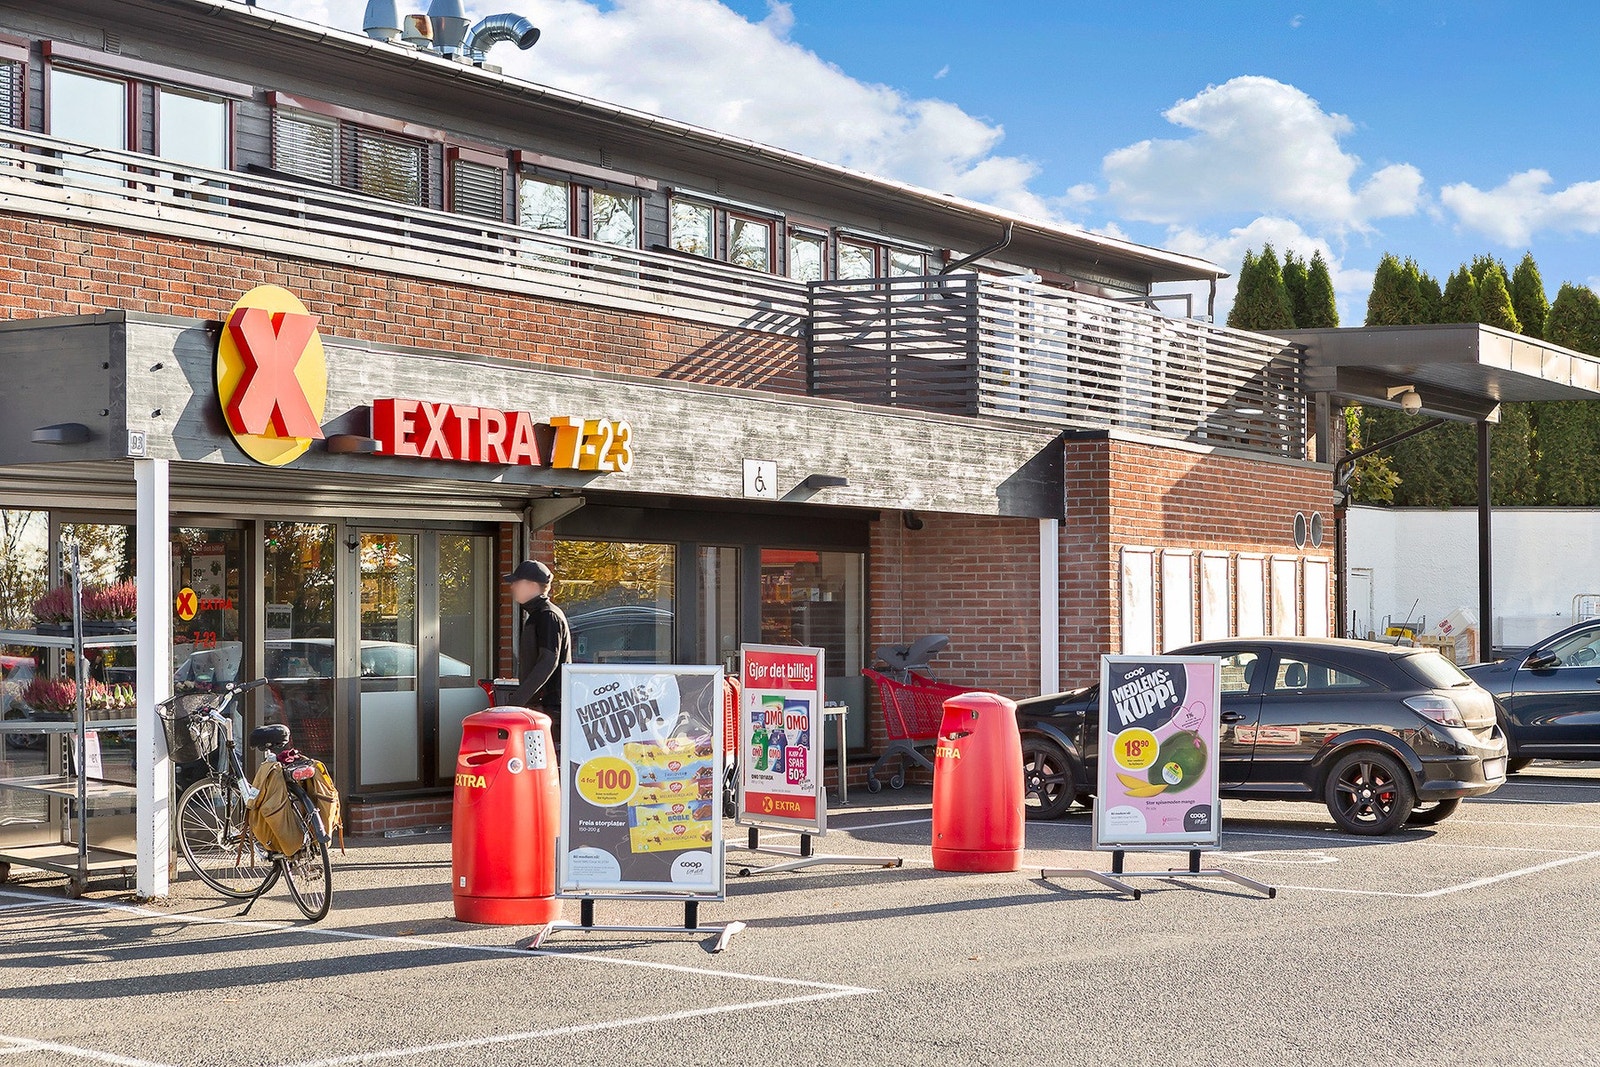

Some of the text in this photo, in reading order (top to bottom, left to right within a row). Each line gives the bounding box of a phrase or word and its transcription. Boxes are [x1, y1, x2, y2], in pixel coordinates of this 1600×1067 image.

[373, 398, 632, 471] EXTRA 7-23
[200, 597, 233, 611] EXTRA
[749, 662, 814, 682] Gjør det billig!
[1124, 666, 1146, 680] coop
[593, 681, 620, 696] coop
[1111, 669, 1170, 704] MEDLEMS-
[576, 684, 653, 725] MEDLEMS-
[1116, 679, 1178, 726] KUPP!
[582, 699, 665, 751] KUPP!
[764, 710, 784, 726] OMO
[786, 714, 809, 731] OMO
[788, 758, 804, 768] SPAR
[596, 769, 631, 790] 100
[789, 768, 805, 780] 50%
[775, 800, 801, 812] EXTRA
[680, 861, 703, 869] coop
